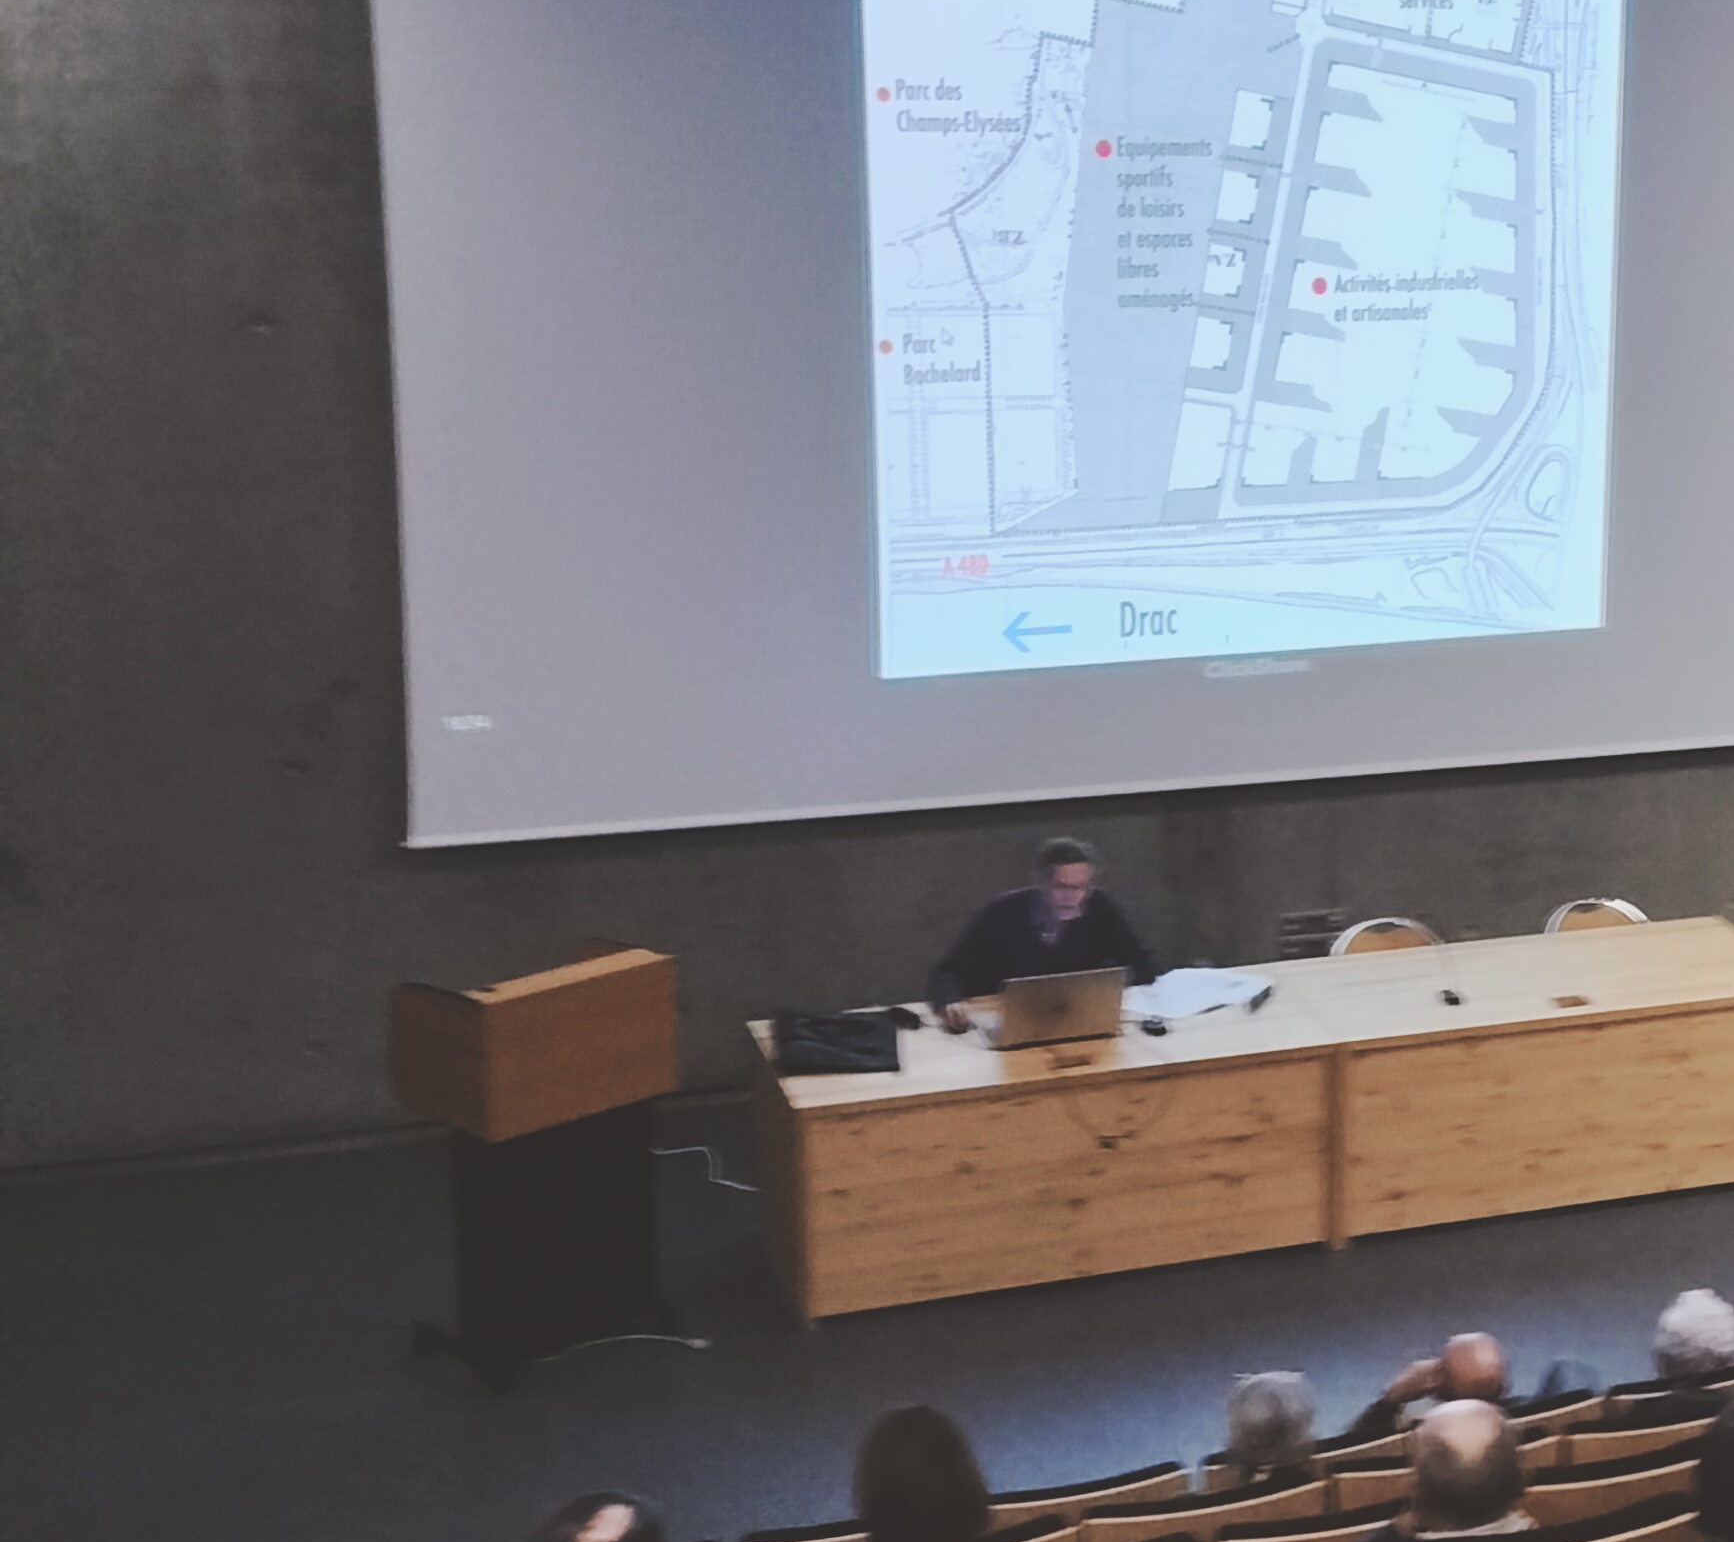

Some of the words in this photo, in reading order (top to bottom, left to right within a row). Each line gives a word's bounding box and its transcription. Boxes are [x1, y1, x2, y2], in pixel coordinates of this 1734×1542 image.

[895, 78, 930, 100] Parc
[935, 76, 963, 100] des
[1117, 164, 1173, 192] sportifs
[1117, 196, 1136, 218] de
[1140, 196, 1185, 218] loisirs
[1118, 231, 1131, 248] et
[1136, 233, 1193, 253] espaces
[1117, 255, 1160, 278] libres
[1118, 288, 1194, 313] aménagés
[1334, 306, 1347, 322] et
[1352, 297, 1428, 321] artisanales
[902, 333, 936, 354] Parc
[903, 359, 981, 385] Bachelard
[1119, 601, 1178, 638] Drac
